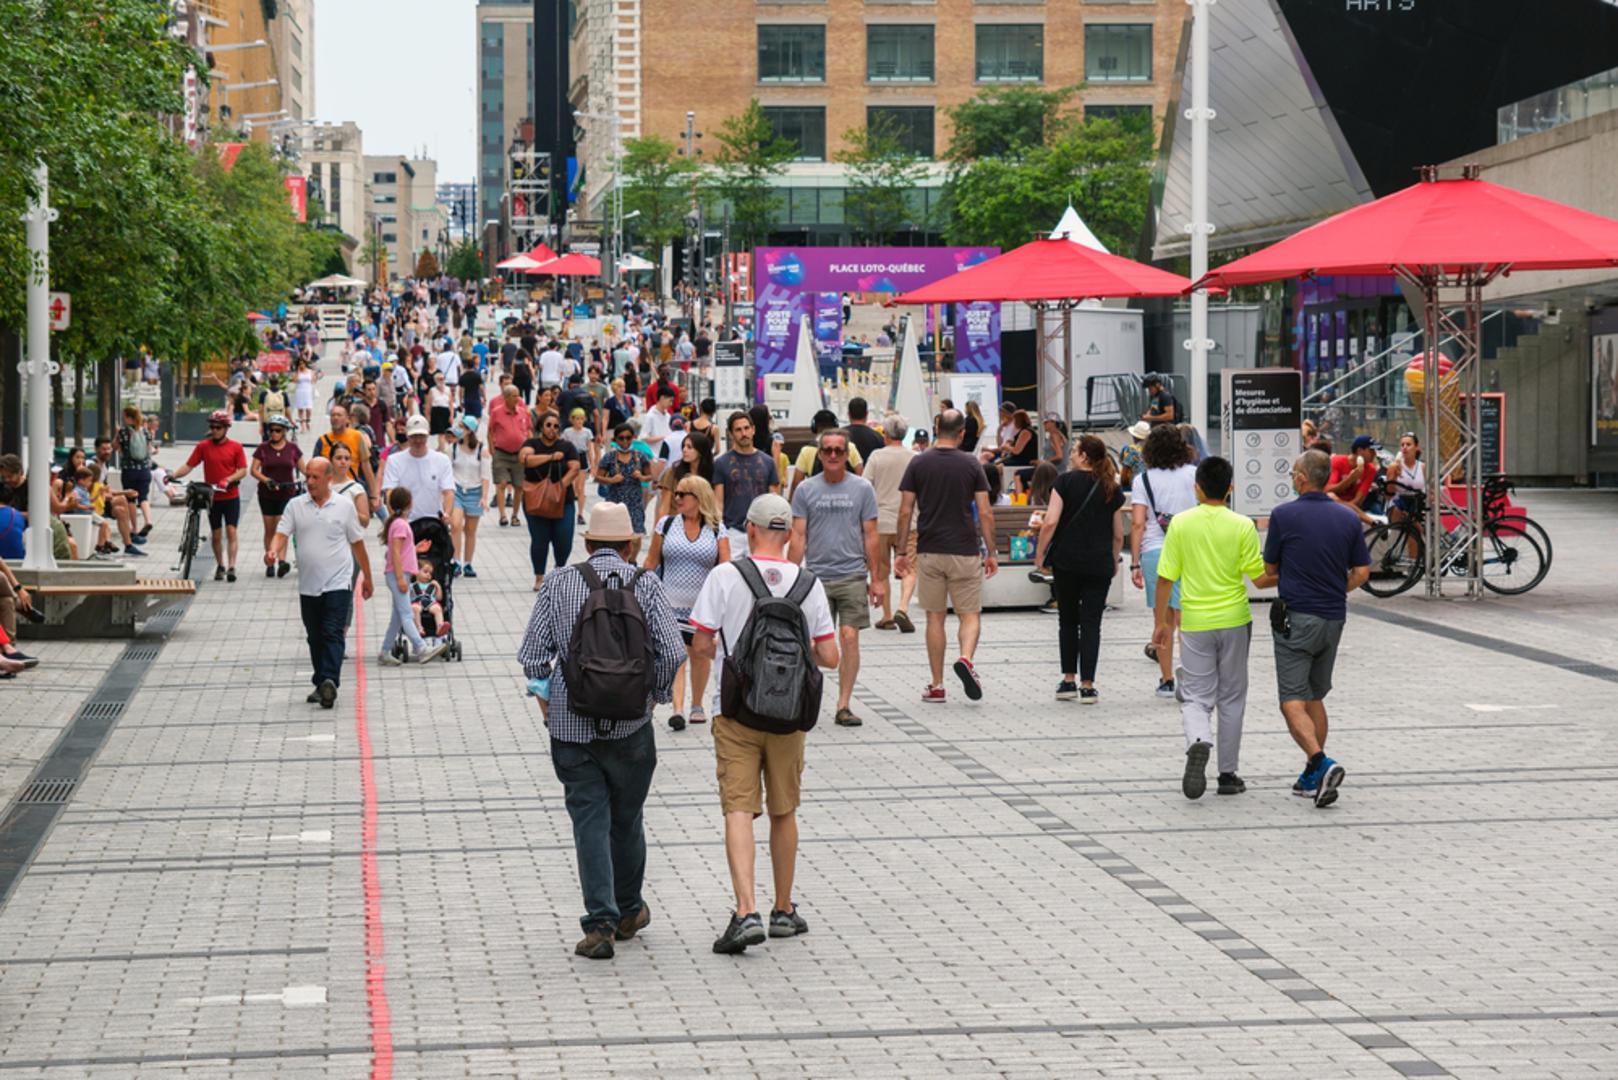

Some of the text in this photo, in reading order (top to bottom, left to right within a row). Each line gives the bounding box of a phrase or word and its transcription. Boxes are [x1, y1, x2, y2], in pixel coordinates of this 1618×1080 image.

[829, 262, 926, 273] PLACE LOTO-QUÉBEC
[1235, 397, 1271, 407] d'hygiène
[1235, 406, 1292, 414] de distanciation
